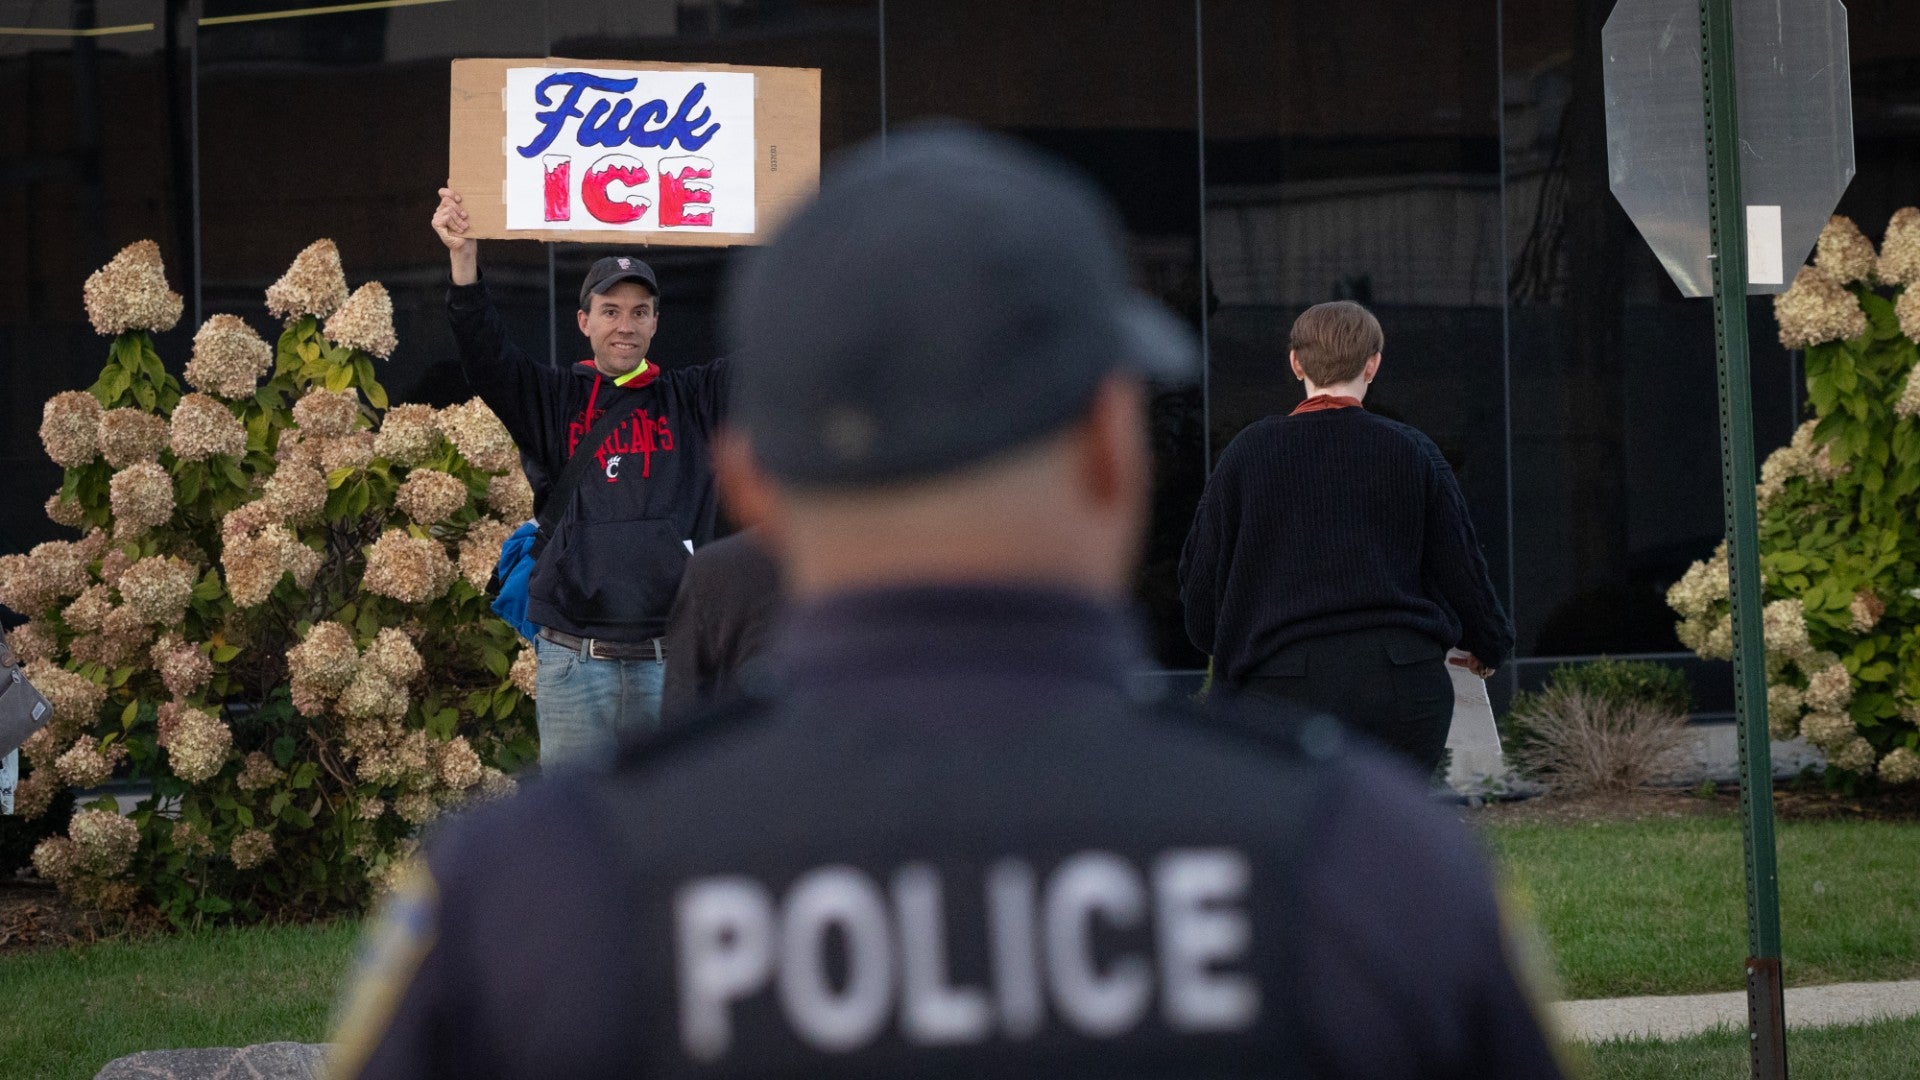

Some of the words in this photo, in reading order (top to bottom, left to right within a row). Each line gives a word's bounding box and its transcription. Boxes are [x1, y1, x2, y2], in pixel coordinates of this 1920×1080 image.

[516, 71, 721, 158] Fuck
[541, 153, 715, 228] ICE
[675, 849, 1262, 1061] POLICE
